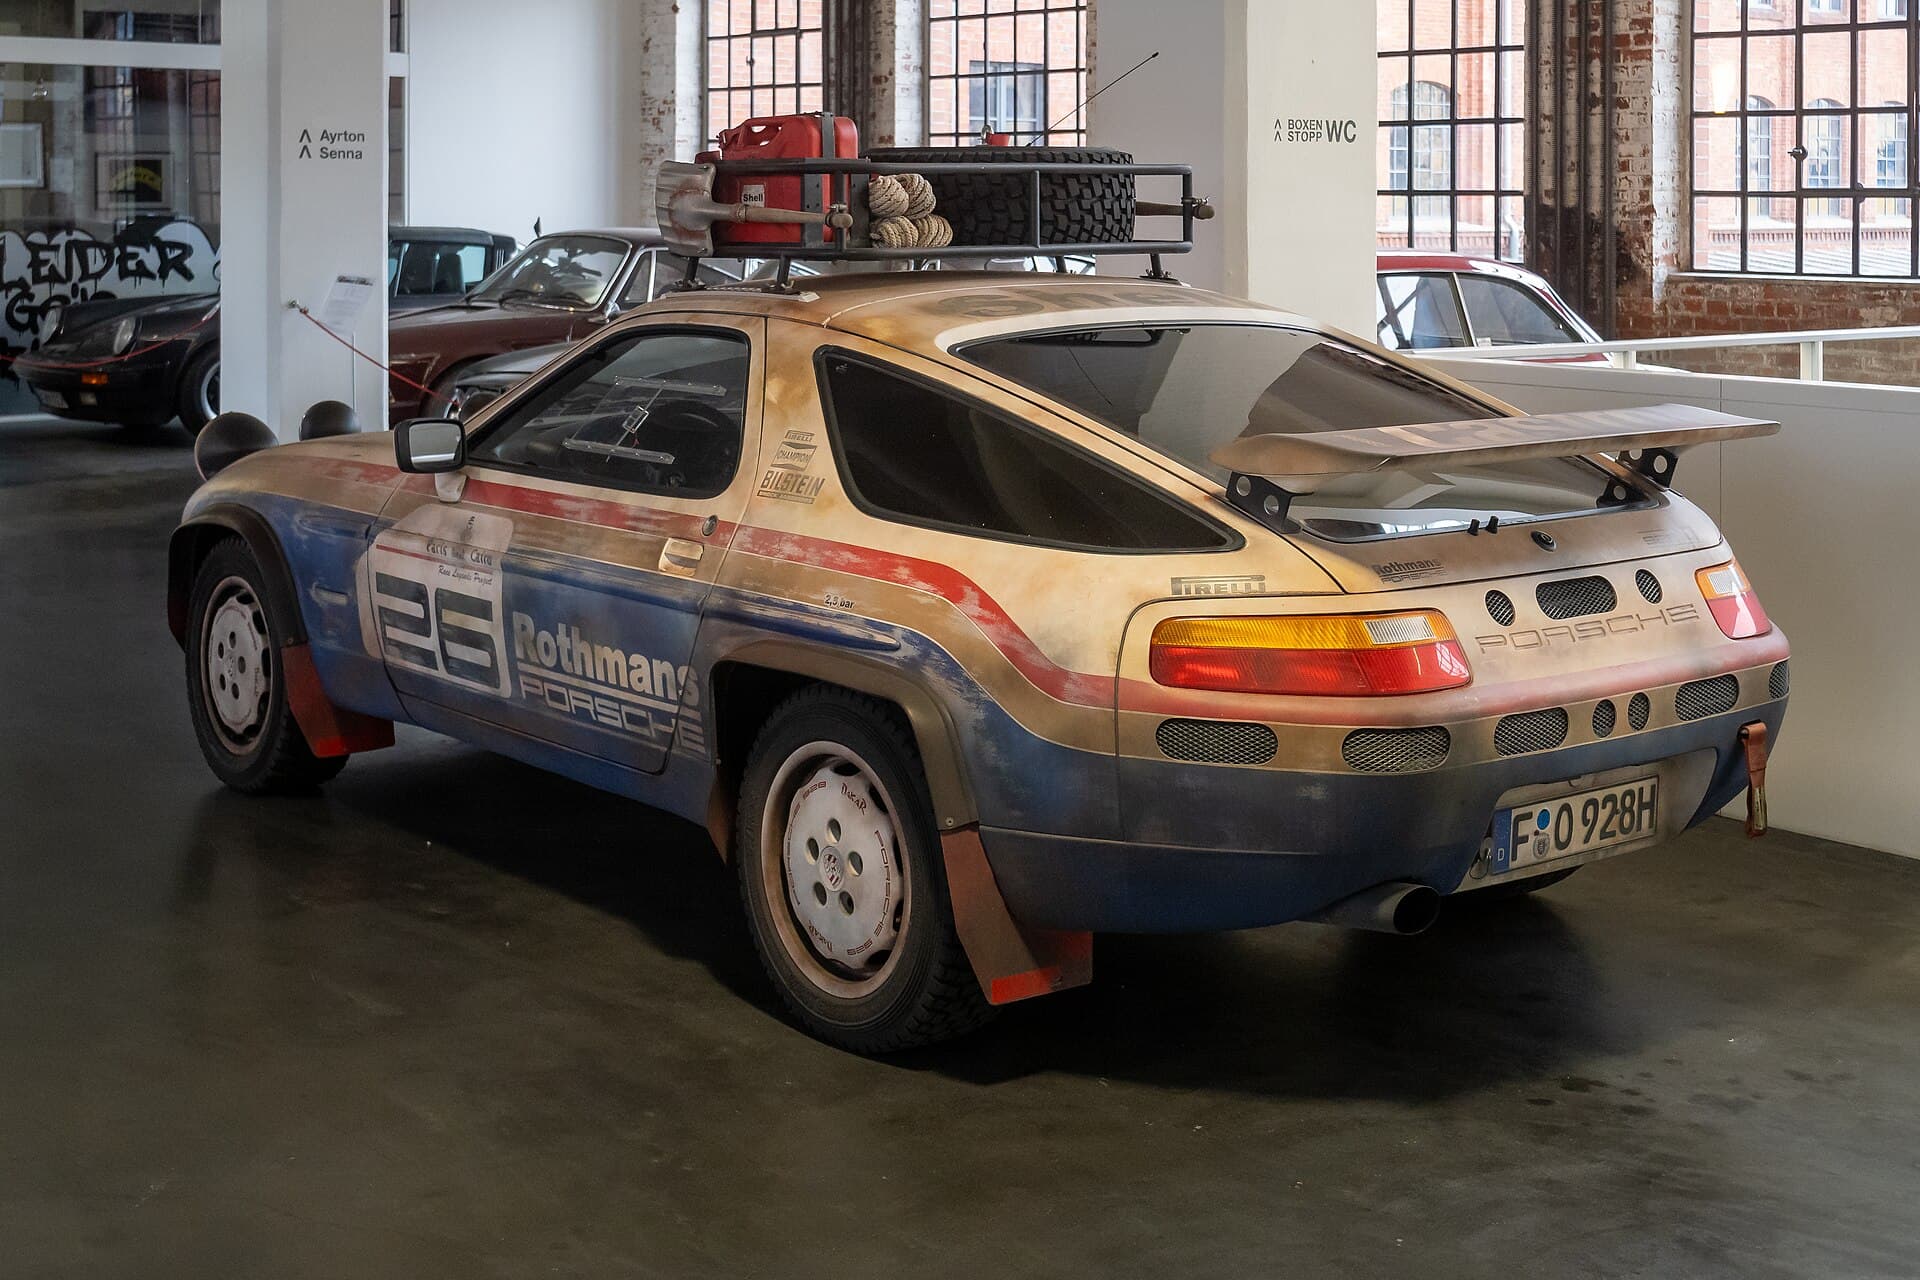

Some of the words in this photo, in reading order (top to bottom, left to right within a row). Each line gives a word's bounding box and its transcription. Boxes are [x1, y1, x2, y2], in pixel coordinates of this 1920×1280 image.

[1287, 119, 1323, 130] BOXEN
[1325, 119, 1356, 143] WC
[320, 129, 365, 144] Ayrton
[1287, 131, 1323, 142] STOPP
[320, 146, 363, 160] Senna
[743, 193, 763, 202] Shell
[761, 470, 825, 497] BILSTEIN
[1372, 559, 1442, 575] Rothmans
[1171, 575, 1266, 595] PIRELLI
[1475, 603, 1700, 654] PORSCHE
[513, 611, 699, 706] Rothmans
[520, 675, 706, 753] PORSCHE
[1511, 811, 1533, 862] F
[1582, 784, 1656, 845] 928H
[1497, 847, 1505, 862] D
